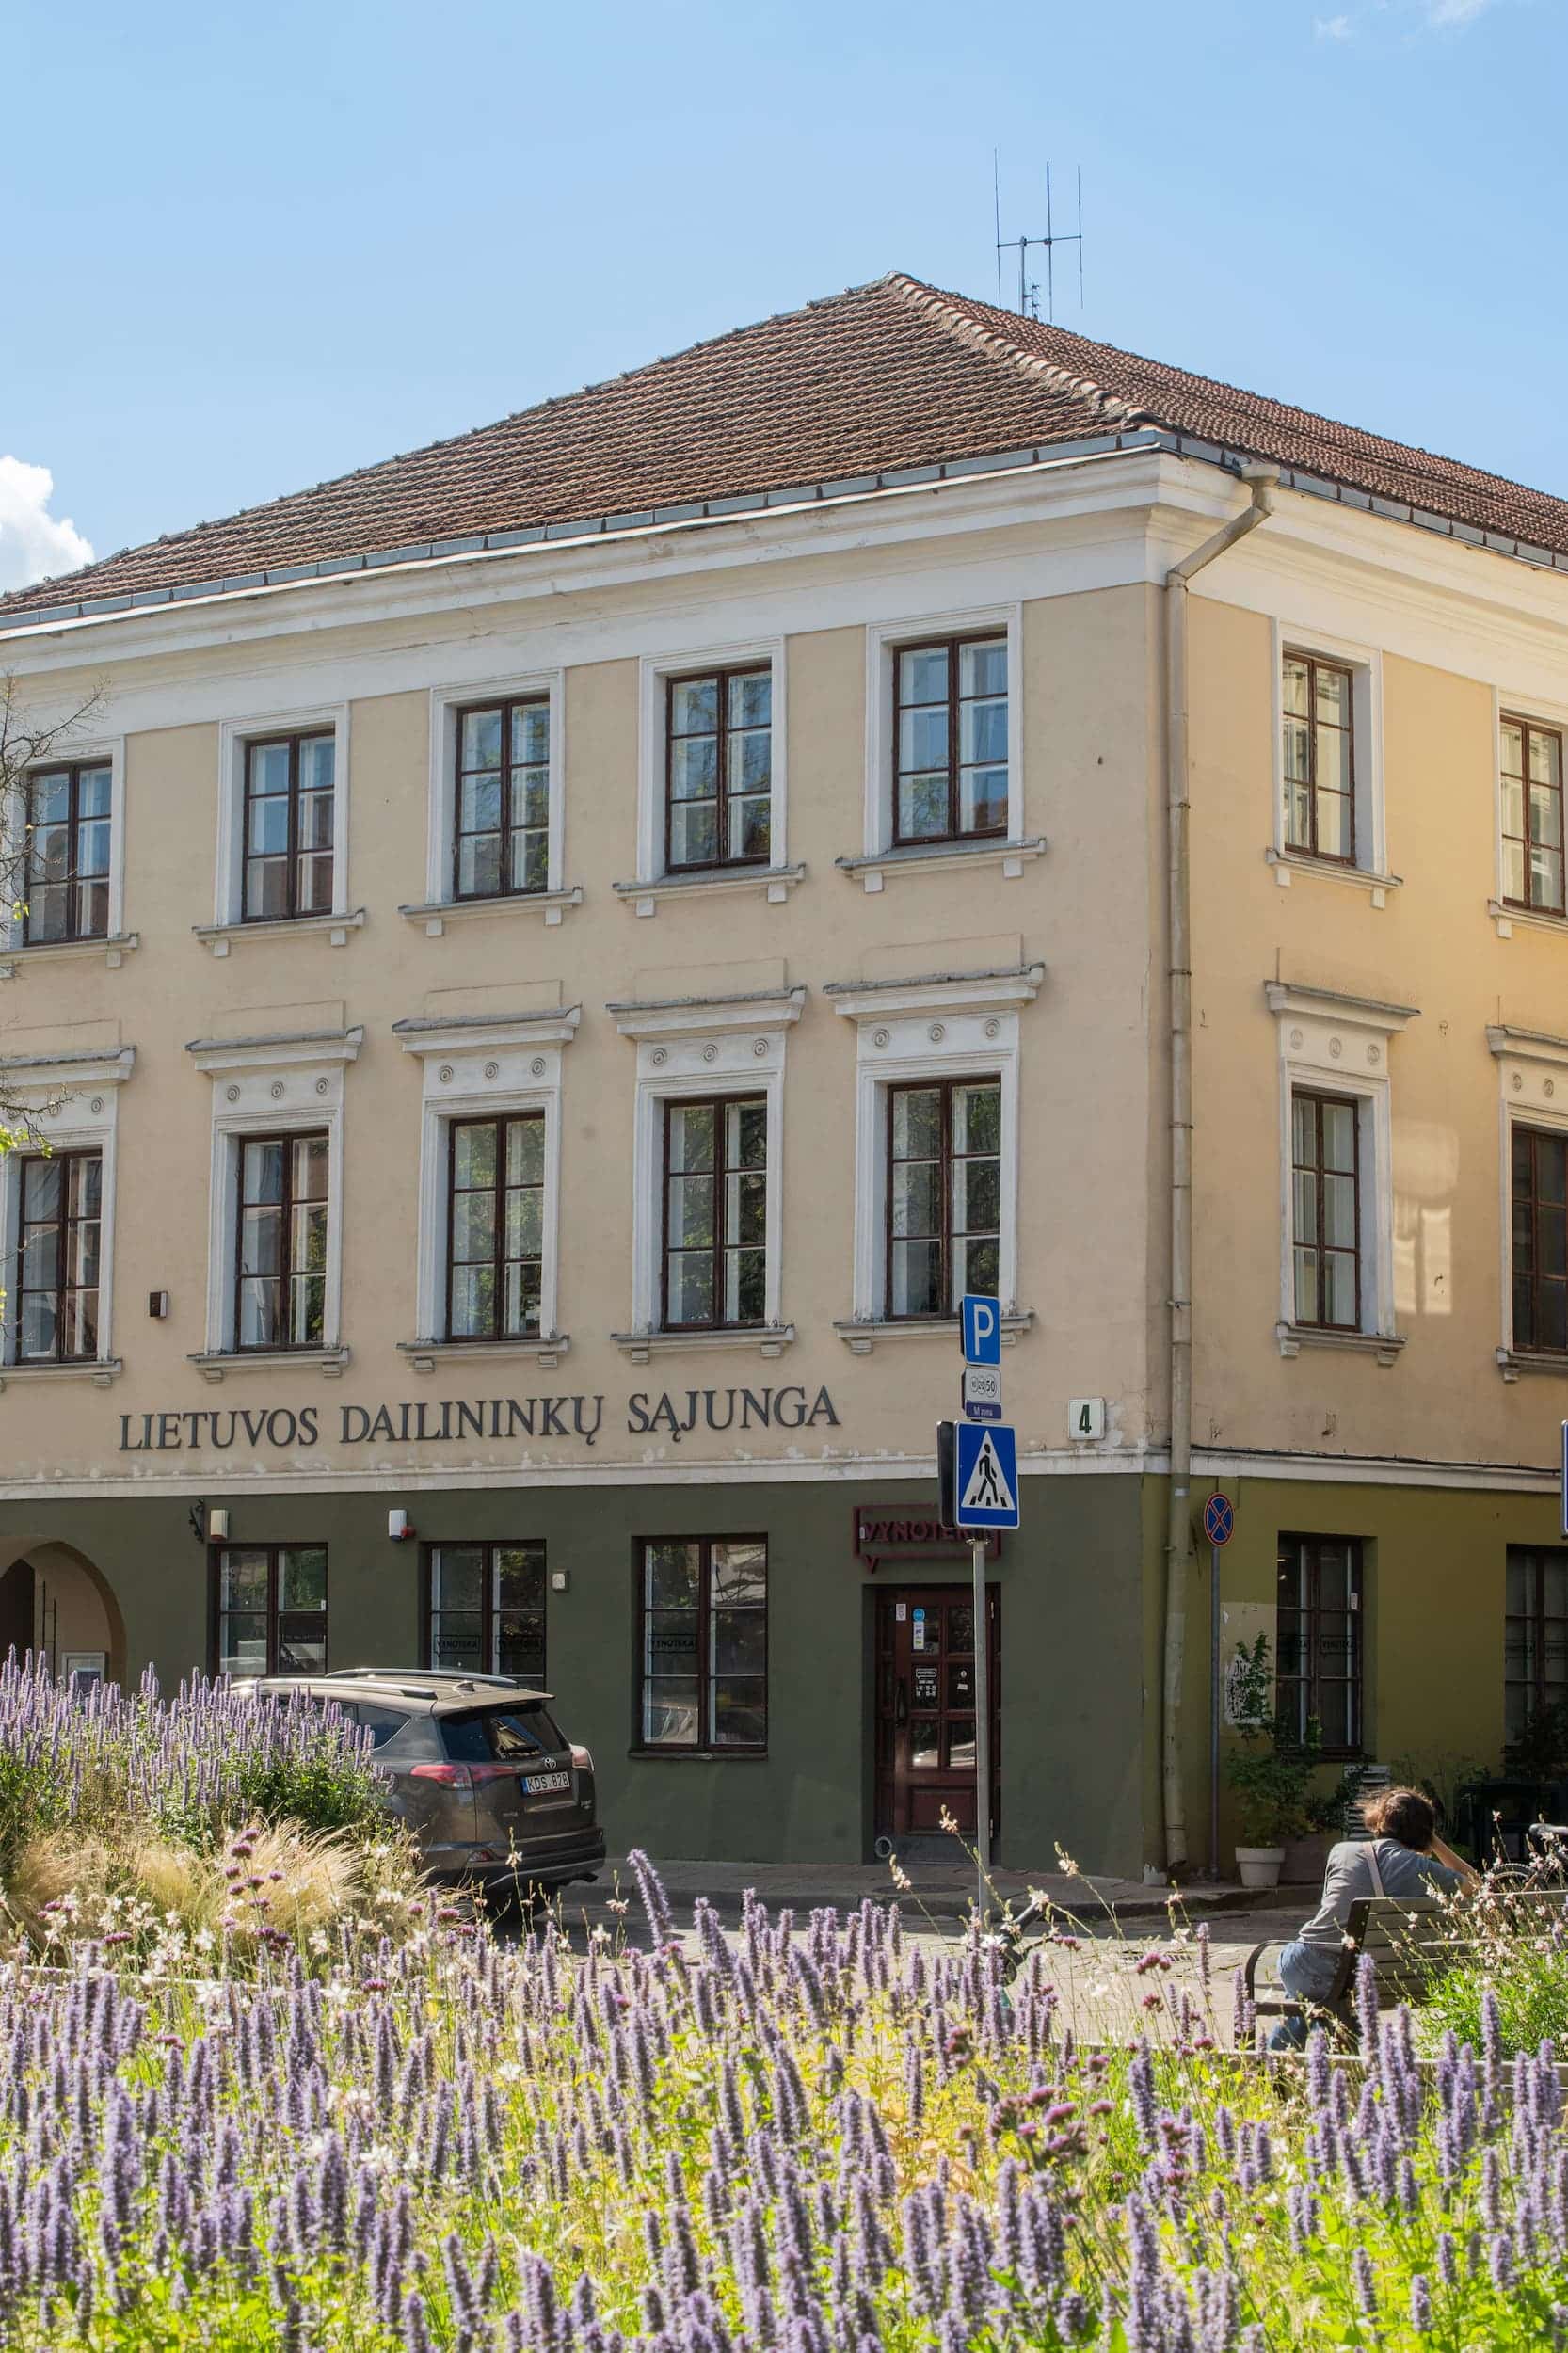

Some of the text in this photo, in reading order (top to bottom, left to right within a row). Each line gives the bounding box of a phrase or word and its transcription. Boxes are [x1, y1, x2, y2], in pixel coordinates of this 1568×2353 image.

[973, 1304, 994, 1356] P
[985, 1380, 995, 1392] 50
[119, 1385, 841, 1450] LIETUVOS DAILININKŲ SĄJUNGA
[1079, 1404, 1092, 1434] 4
[862, 1520, 995, 1542] VYNOTEK
[527, 1773, 568, 1792] KDS 828
